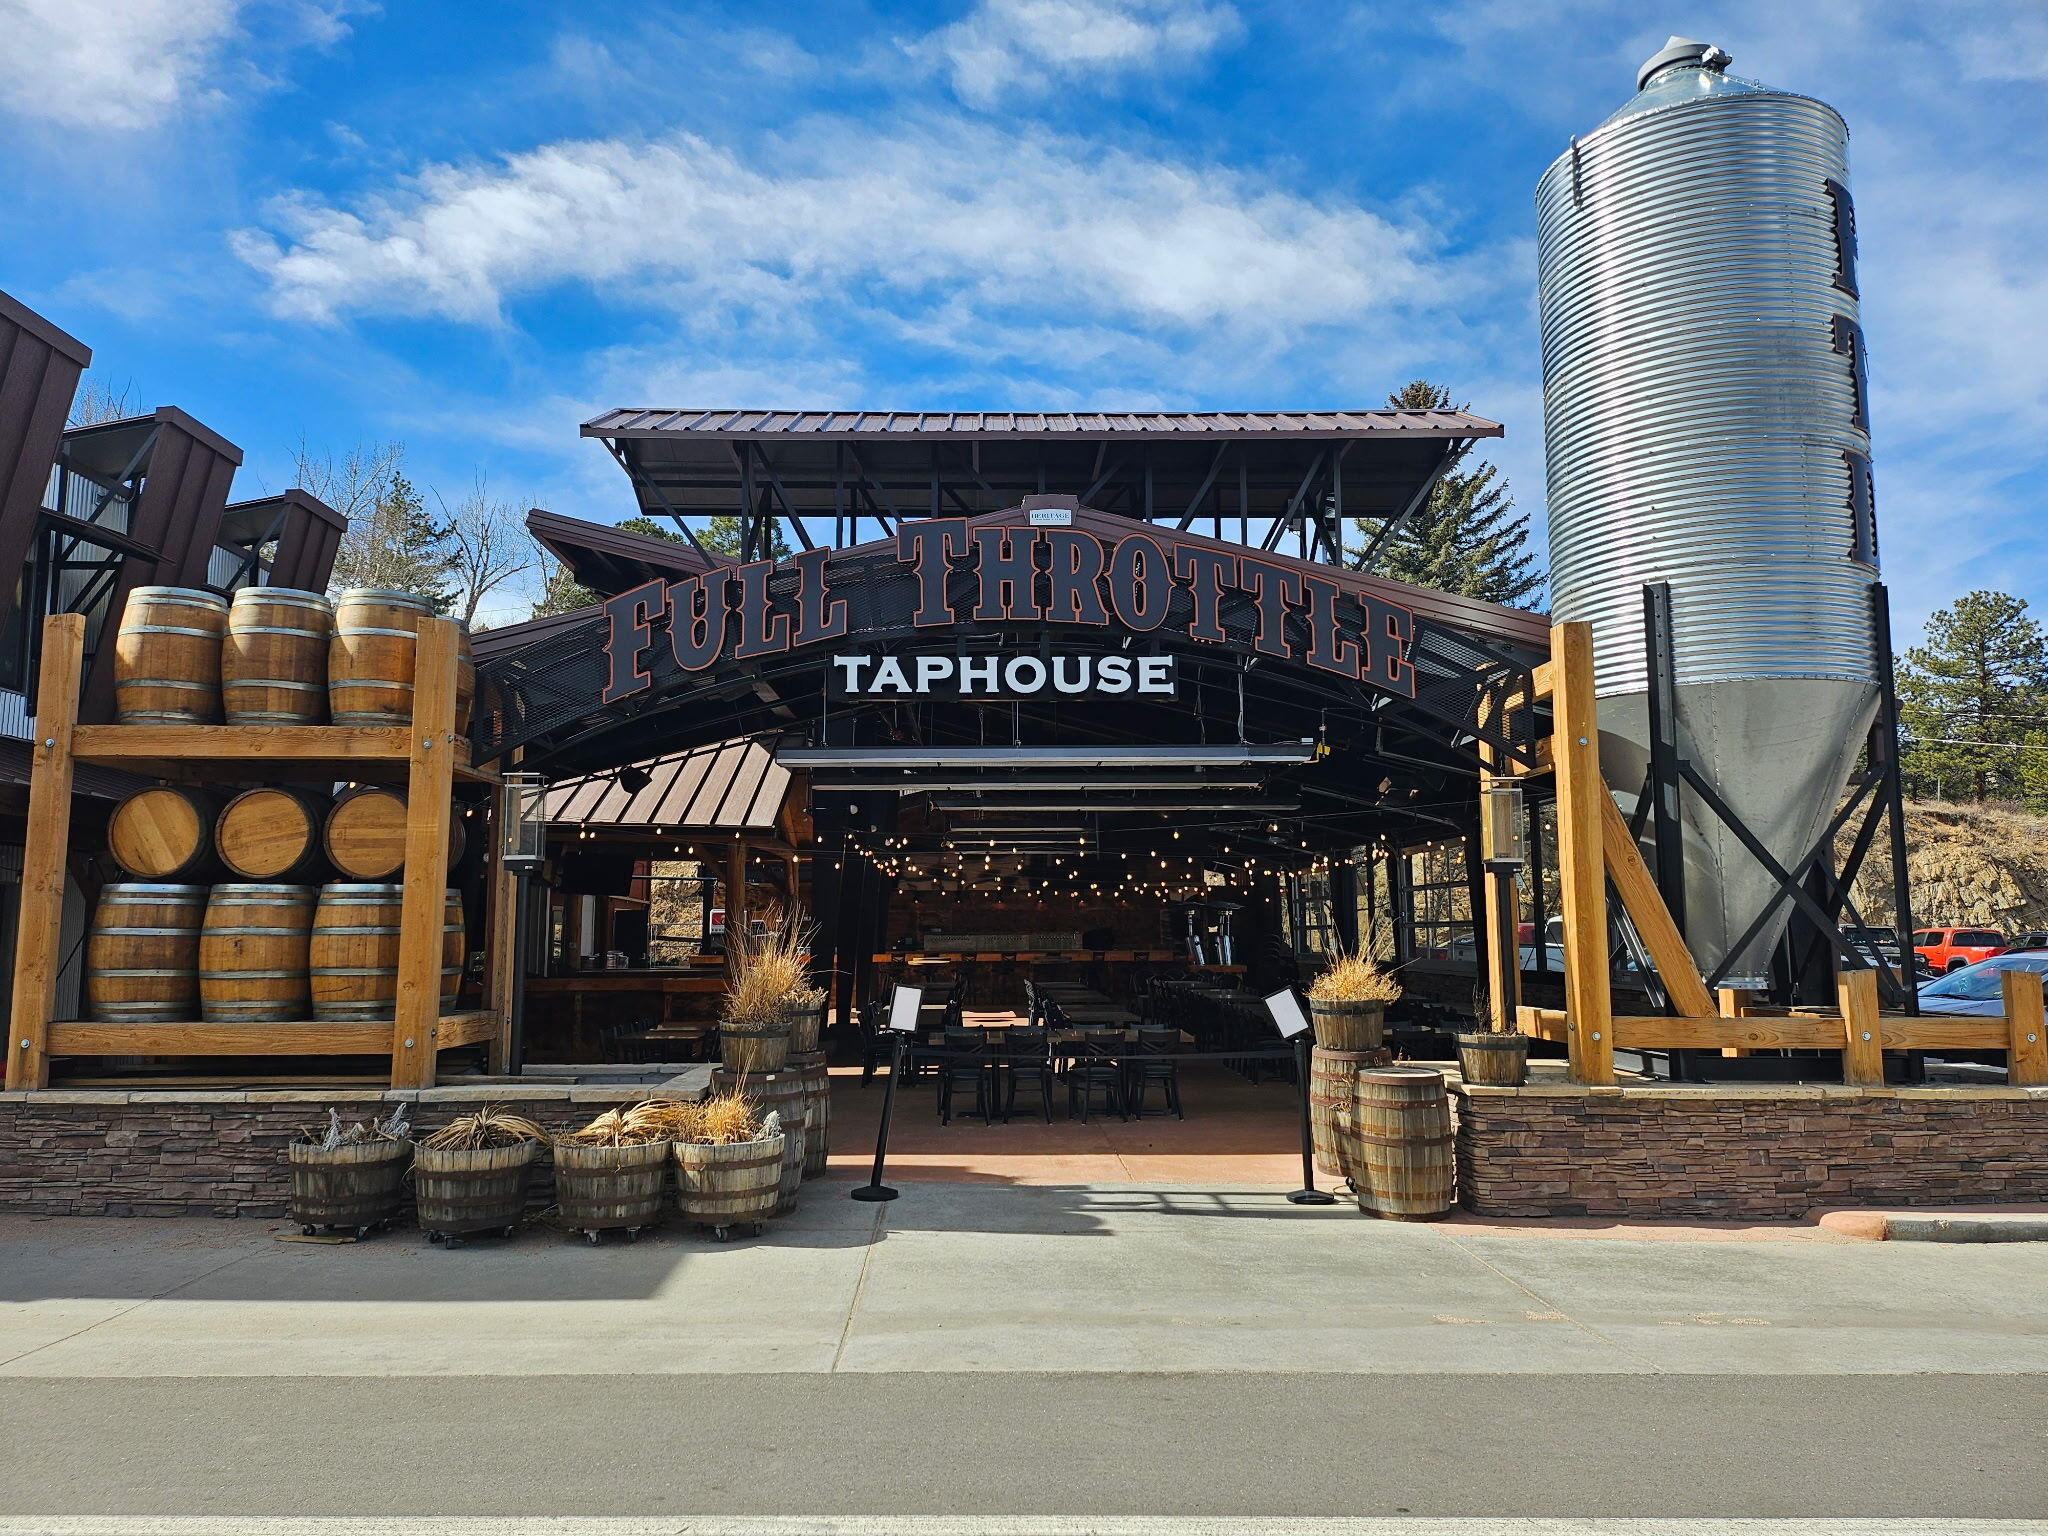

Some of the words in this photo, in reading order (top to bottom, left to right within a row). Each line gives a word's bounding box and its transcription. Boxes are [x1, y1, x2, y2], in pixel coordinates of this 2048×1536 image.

[602, 546, 848, 704] FULL
[896, 516, 1416, 699] THROTTLE
[833, 654, 1175, 695] TAPHOUSE
